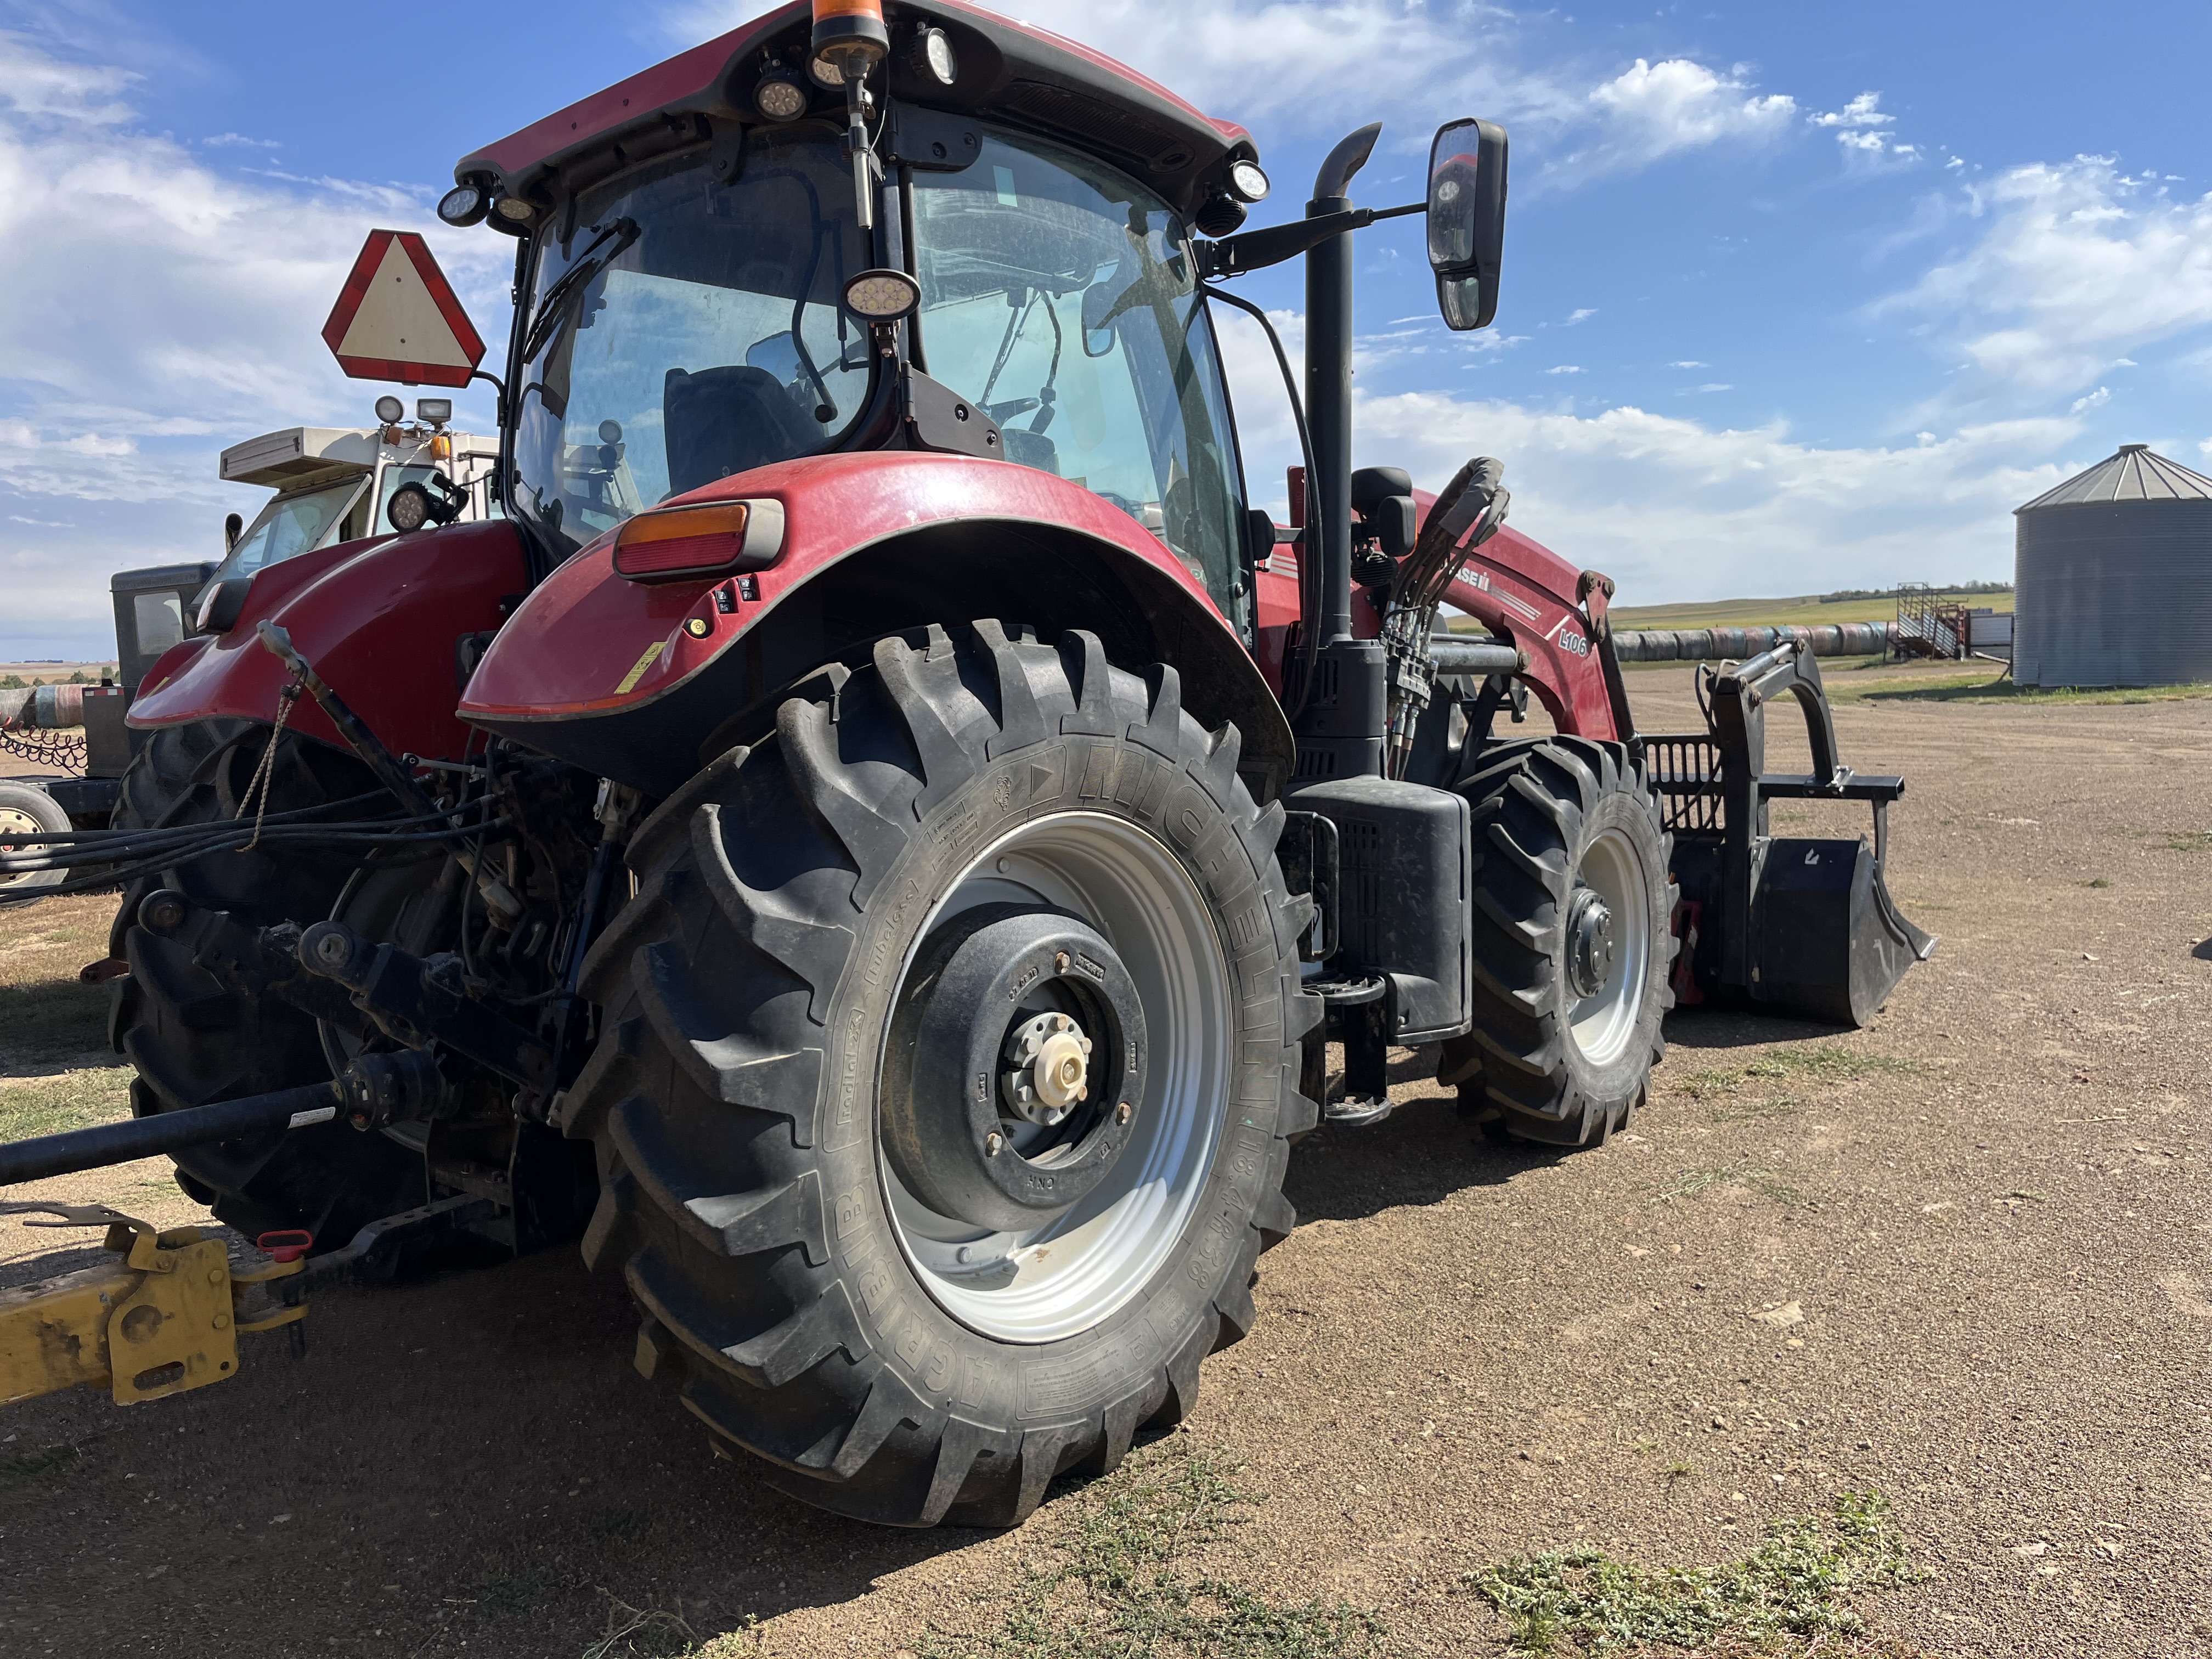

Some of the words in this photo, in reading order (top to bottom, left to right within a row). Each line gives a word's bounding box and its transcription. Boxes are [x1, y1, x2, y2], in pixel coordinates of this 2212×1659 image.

[1558, 628, 1587, 657] L106
[869, 889, 915, 977] tubeless
[1079, 744, 1280, 1101] MICHELIN
[842, 1052, 857, 1118] radial
[1027, 1175, 1054, 1190] CNH
[834, 1184, 994, 1409] AGRIBIB
